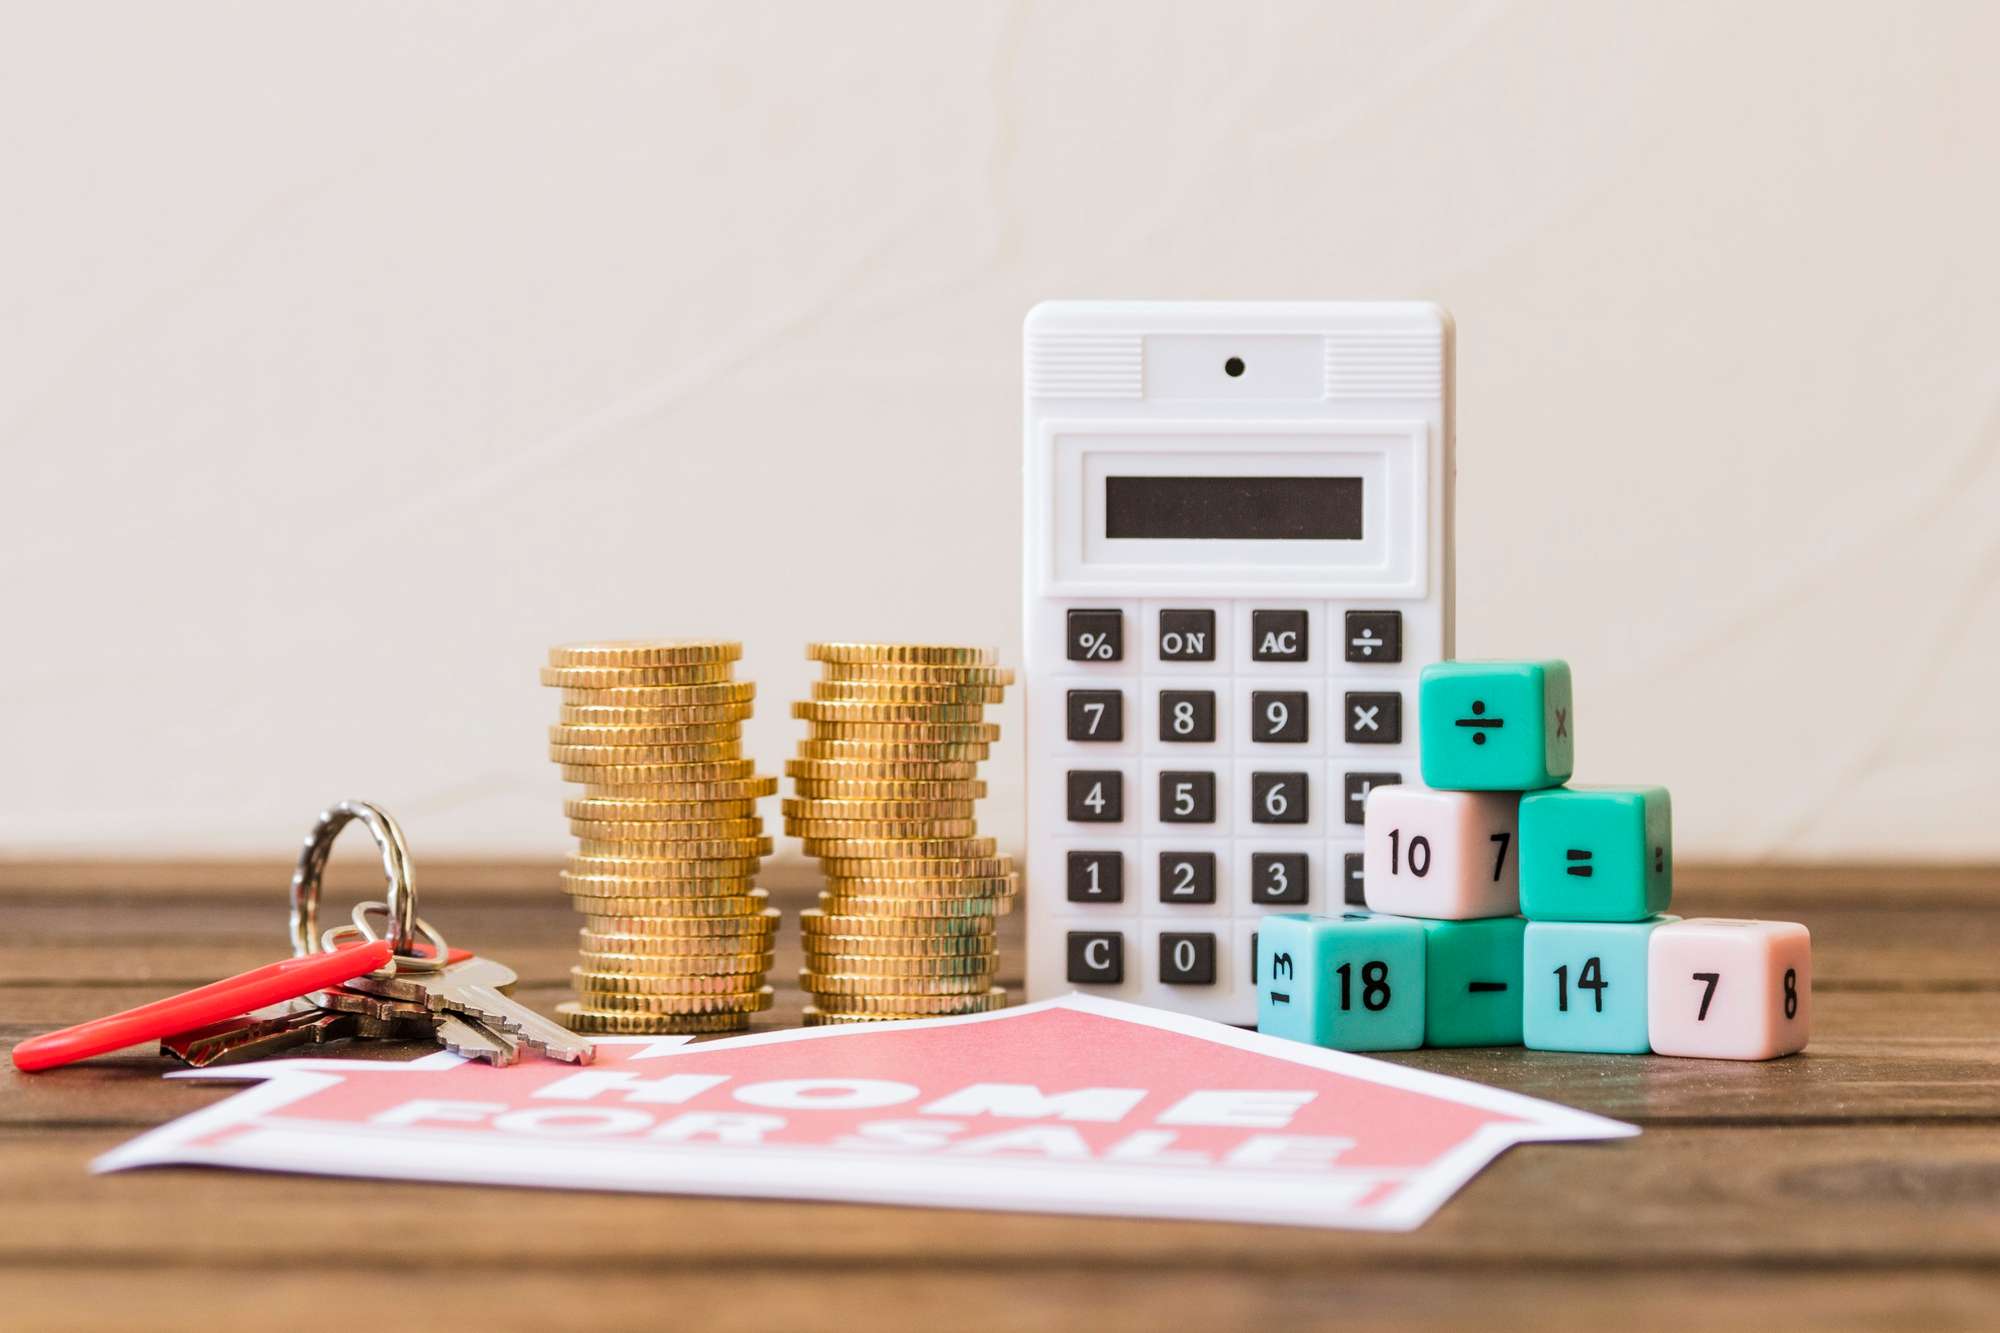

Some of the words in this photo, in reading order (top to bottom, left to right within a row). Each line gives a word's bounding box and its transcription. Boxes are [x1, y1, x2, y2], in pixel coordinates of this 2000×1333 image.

[1080, 633, 1113, 659] %
[1162, 632, 1206, 654] ON
[1259, 631, 1297, 654] AC
[1083, 703, 1105, 735] 7
[1173, 701, 1195, 734] 8
[1266, 701, 1288, 734] 9
[1084, 782, 1106, 814] 4
[1174, 783, 1195, 815] 5
[1266, 783, 1288, 816] 6
[1388, 828, 1431, 878] 10
[1488, 832, 1512, 883] 7
[1086, 861, 1103, 894] 1
[1173, 862, 1195, 895] 2
[1267, 862, 1288, 895] 3
[1084, 939, 1110, 970] C
[1174, 940, 1196, 972] 0
[1270, 952, 1293, 1006] 13
[1335, 959, 1392, 1012] 18
[1552, 956, 1609, 1013] 14
[1783, 967, 1799, 1021] 8
[1692, 972, 1720, 1021] 7
[529, 1070, 1319, 1129] HOME
[366, 1098, 788, 1146] FOR
[832, 1118, 1358, 1168] SALE
